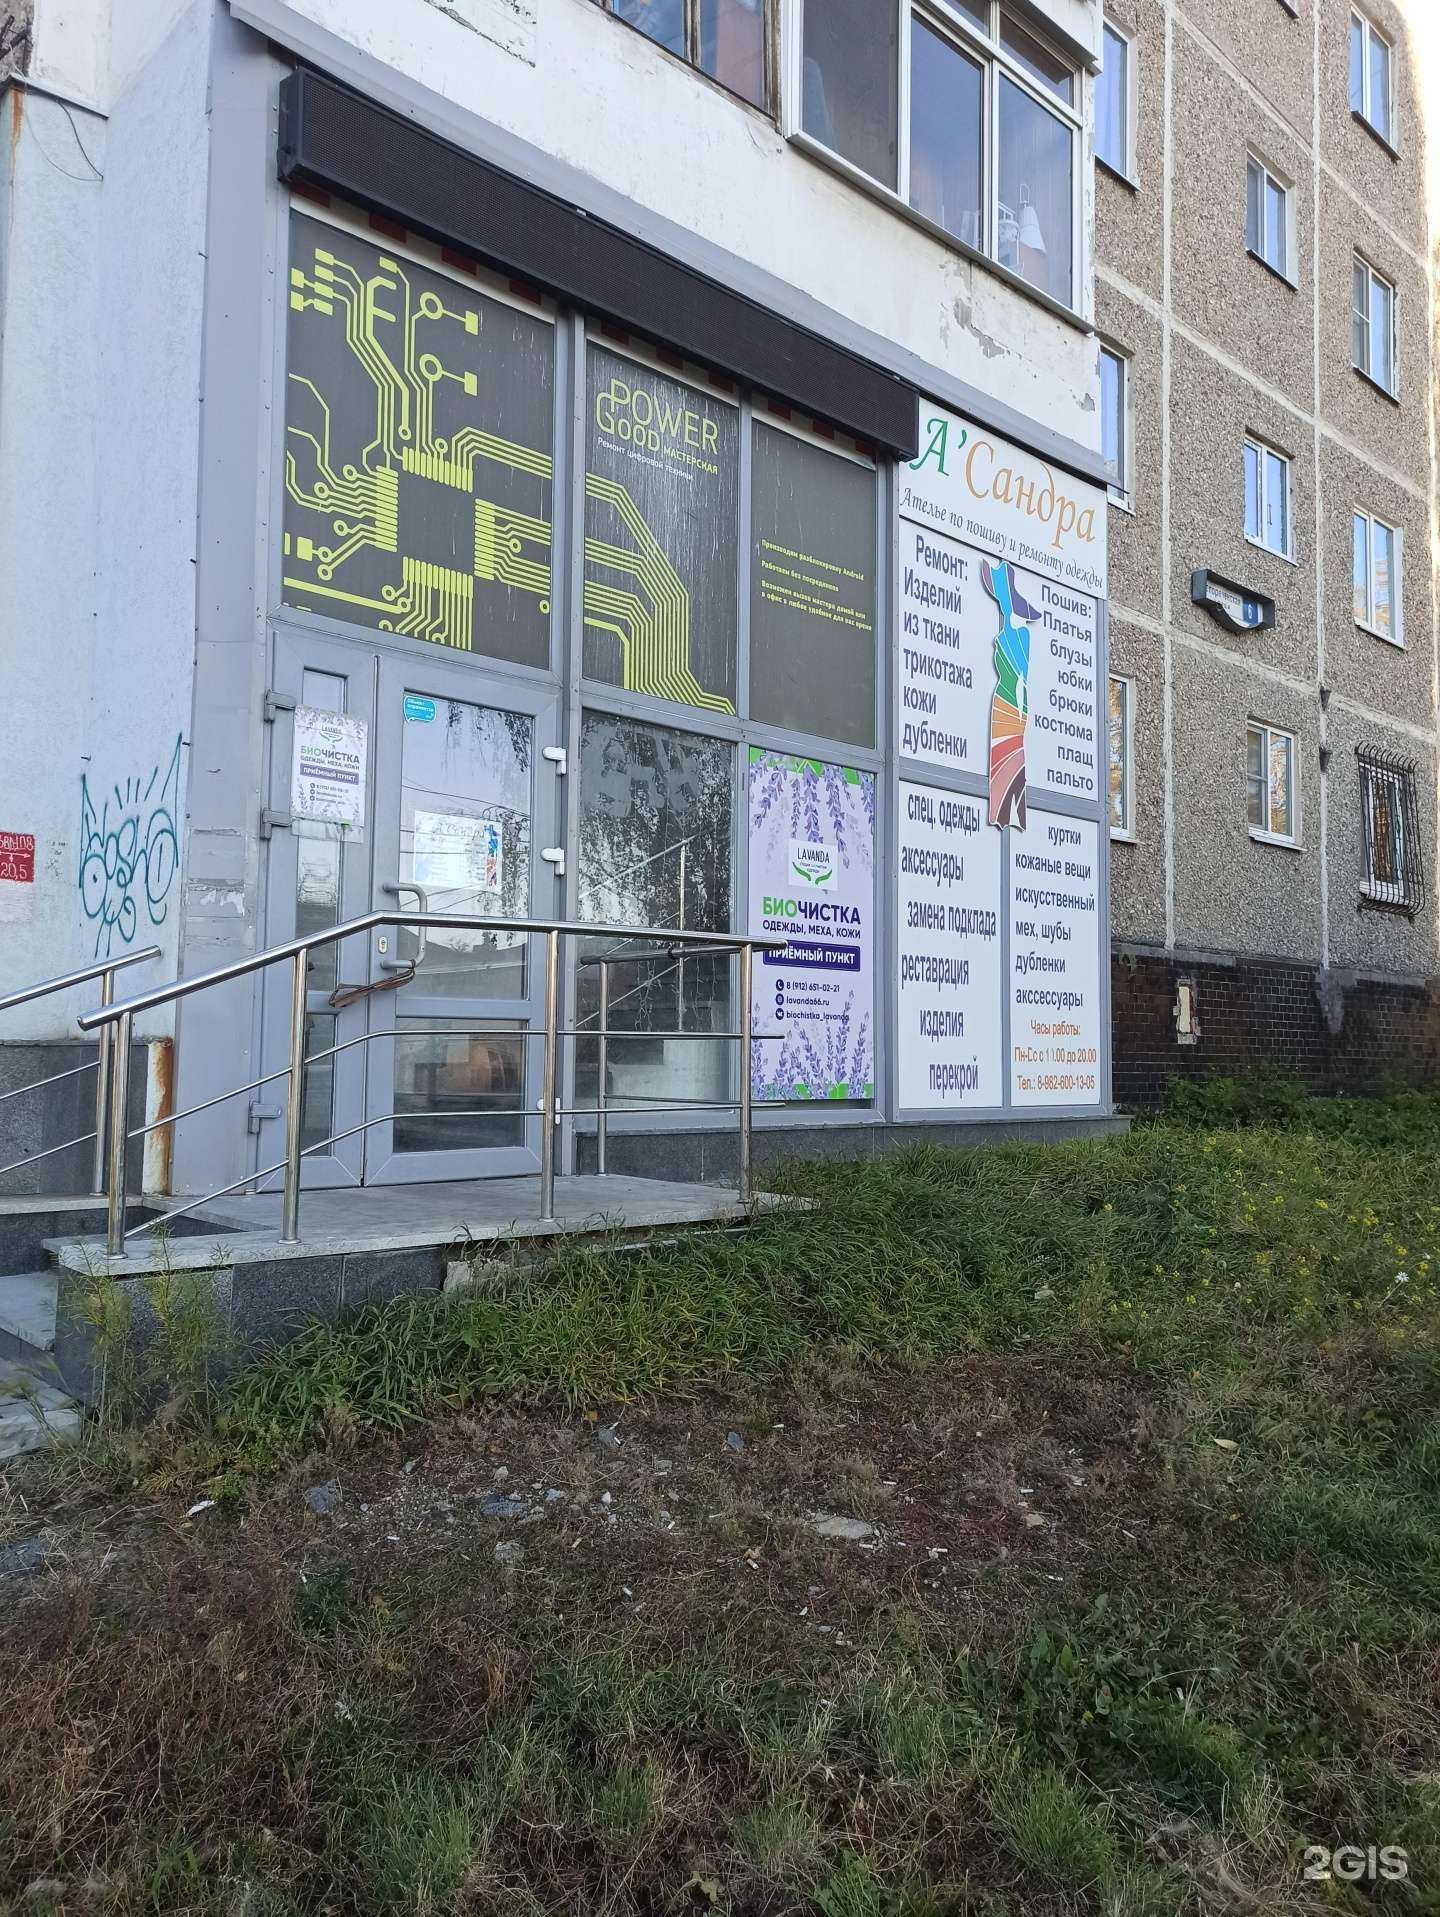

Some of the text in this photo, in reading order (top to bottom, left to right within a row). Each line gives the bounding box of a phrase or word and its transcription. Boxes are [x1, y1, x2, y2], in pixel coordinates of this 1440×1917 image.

[596, 392, 660, 452] GOOD
[611, 378, 718, 455] POWER
[597, 437, 626, 455] Ремонт
[626, 449, 664, 470] цифровой
[663, 446, 719, 475] МАСТЕРСКАЯ
[899, 487, 1103, 589] Ателье по пошиву и ремонту одежды
[915, 534, 969, 581] Ремонт:
[904, 566, 962, 614] Изделий
[1041, 583, 1092, 619] Пошив:
[1247, 603, 1254, 619] 6
[903, 611, 960, 650] из ткани
[1043, 610, 1092, 644] Платья
[1050, 638, 1093, 668] блузы
[903, 648, 973, 689] трикотажа
[1058, 669, 1093, 692] юбки
[903, 685, 937, 715] кожи
[1050, 689, 1093, 717] брюки
[903, 720, 967, 759] дубленки
[1034, 714, 1093, 742] костюма
[301, 745, 360, 764] БИОЧИСТКА
[1057, 746, 1094, 769] плащ
[1047, 768, 1094, 792] пальто
[907, 793, 980, 837] спец. одежды
[1048, 825, 1082, 846] куртки
[797, 847, 830, 863] LAVANDA
[901, 845, 964, 888] аксессуары
[1015, 852, 1091, 880] кожаные вещи
[762, 896, 861, 925] БИОЧИСТКА
[1015, 886, 1095, 912] искусственный
[762, 919, 861, 940] ОДЕЖДЫ, МЕХА, КОЖИ
[907, 900, 997, 942] замена подклада
[1015, 920, 1071, 945] мех, шубы
[768, 946, 856, 965] ПРИЁМНЫЙ ПУНКТ
[1015, 951, 1066, 975] дубленки
[901, 953, 969, 992] реставрация
[792, 981, 808, 992] (912)
[808, 983, 840, 993] 651-02-21
[1015, 988, 1084, 1011] акссессуары
[786, 996, 830, 1007] lavanda66.ru
[786, 1010, 850, 1022] biochistka_lavanda
[919, 1008, 964, 1043] изделия
[1030, 1019, 1081, 1039] Часы работы:
[1077, 1048, 1097, 1064] 20.00
[929, 1055, 979, 1099] перекрой
